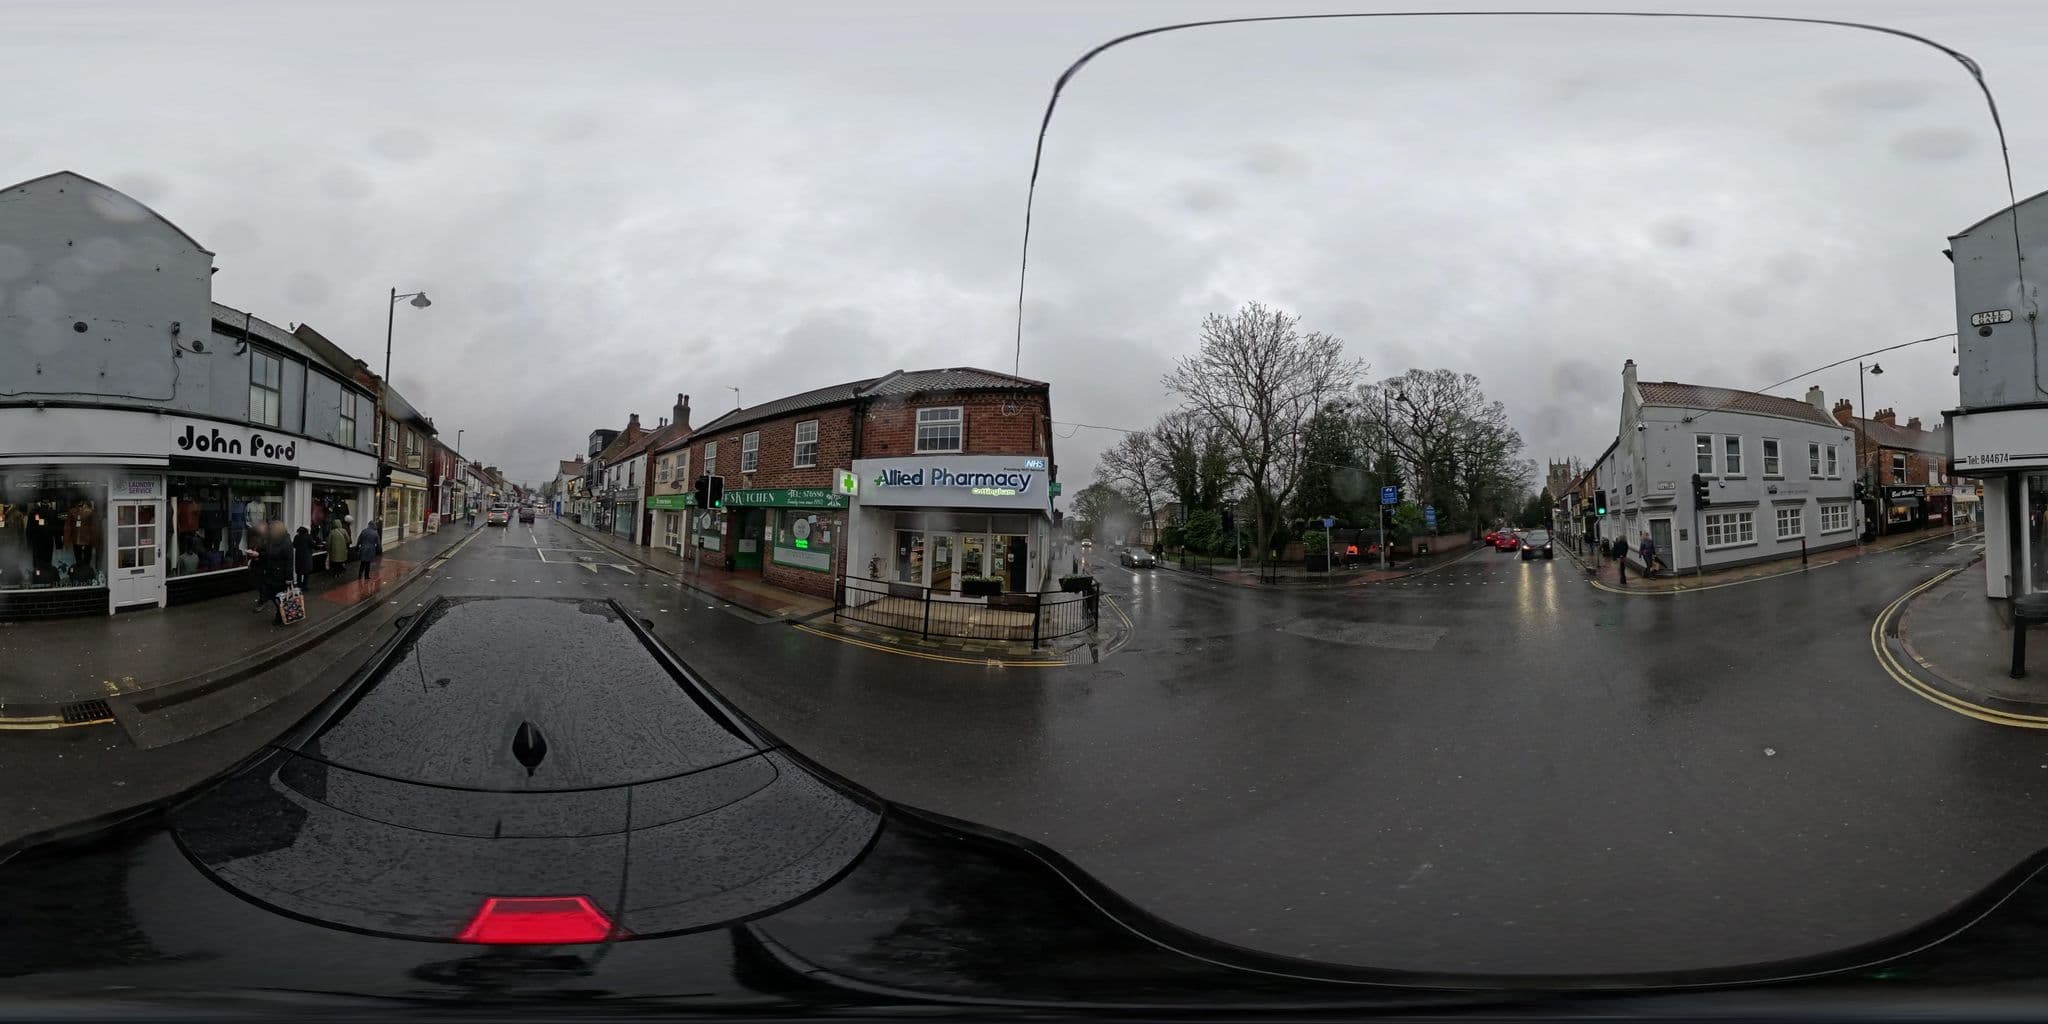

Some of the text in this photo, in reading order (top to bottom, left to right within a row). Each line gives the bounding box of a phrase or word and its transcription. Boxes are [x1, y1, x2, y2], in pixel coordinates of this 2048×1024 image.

[177, 425, 296, 461] John Ford
[1026, 459, 1043, 468] NHS
[1967, 453, 2009, 465] Tel: 844674
[881, 468, 1031, 492] Allied Pharmacy
[971, 487, 1016, 497] Cottingham
